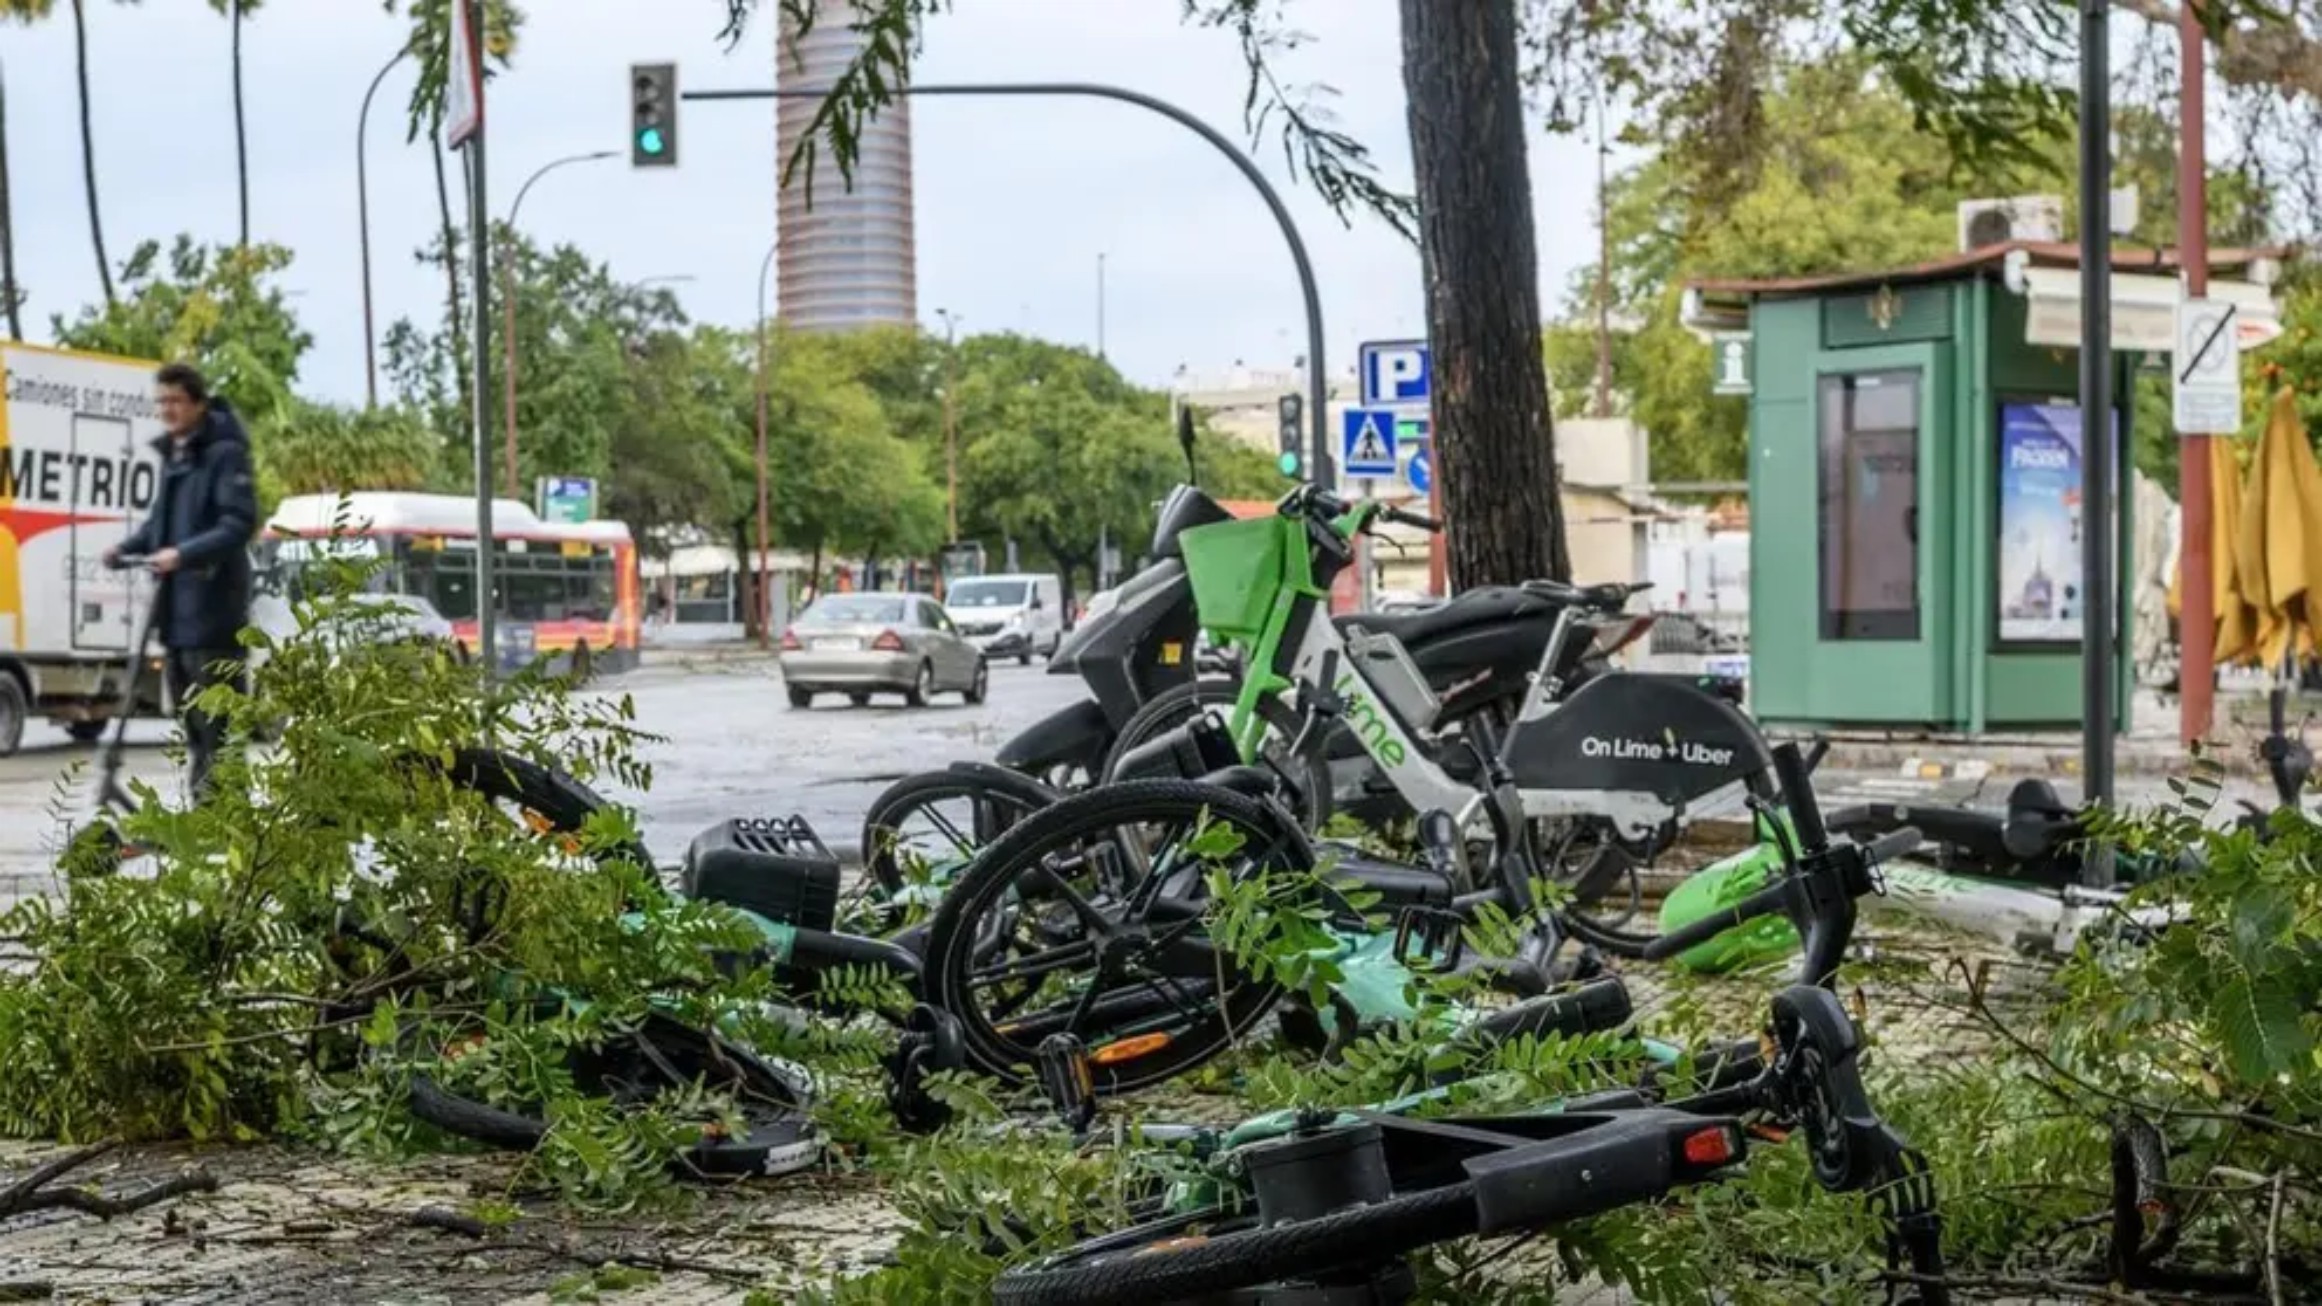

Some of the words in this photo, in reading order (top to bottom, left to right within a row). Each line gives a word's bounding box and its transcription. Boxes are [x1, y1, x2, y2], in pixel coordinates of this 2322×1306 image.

[4, 368, 78, 408] Camiones
[1378, 351, 1422, 400] P
[0, 446, 154, 511] METRIO
[1582, 736, 1611, 757] On
[1614, 737, 1663, 759] Lime
[1682, 742, 1733, 765] Uber
